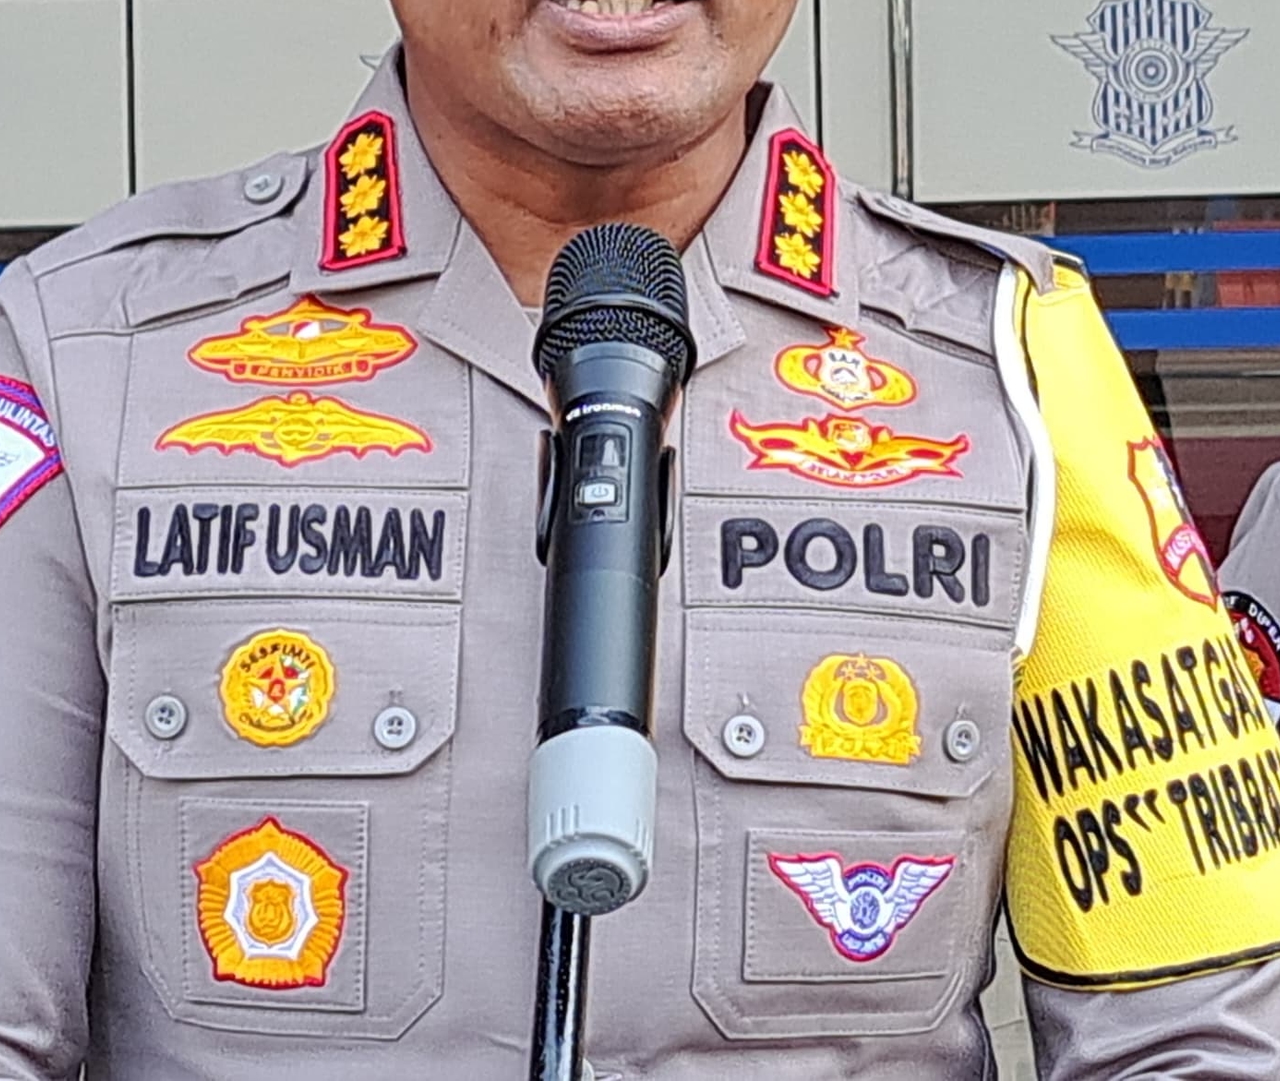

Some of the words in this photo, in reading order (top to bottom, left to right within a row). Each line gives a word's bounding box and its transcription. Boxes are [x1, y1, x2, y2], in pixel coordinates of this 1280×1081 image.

[134, 503, 260, 577] LATIF
[266, 503, 446, 581] USMAN
[721, 517, 990, 608] POLRI
